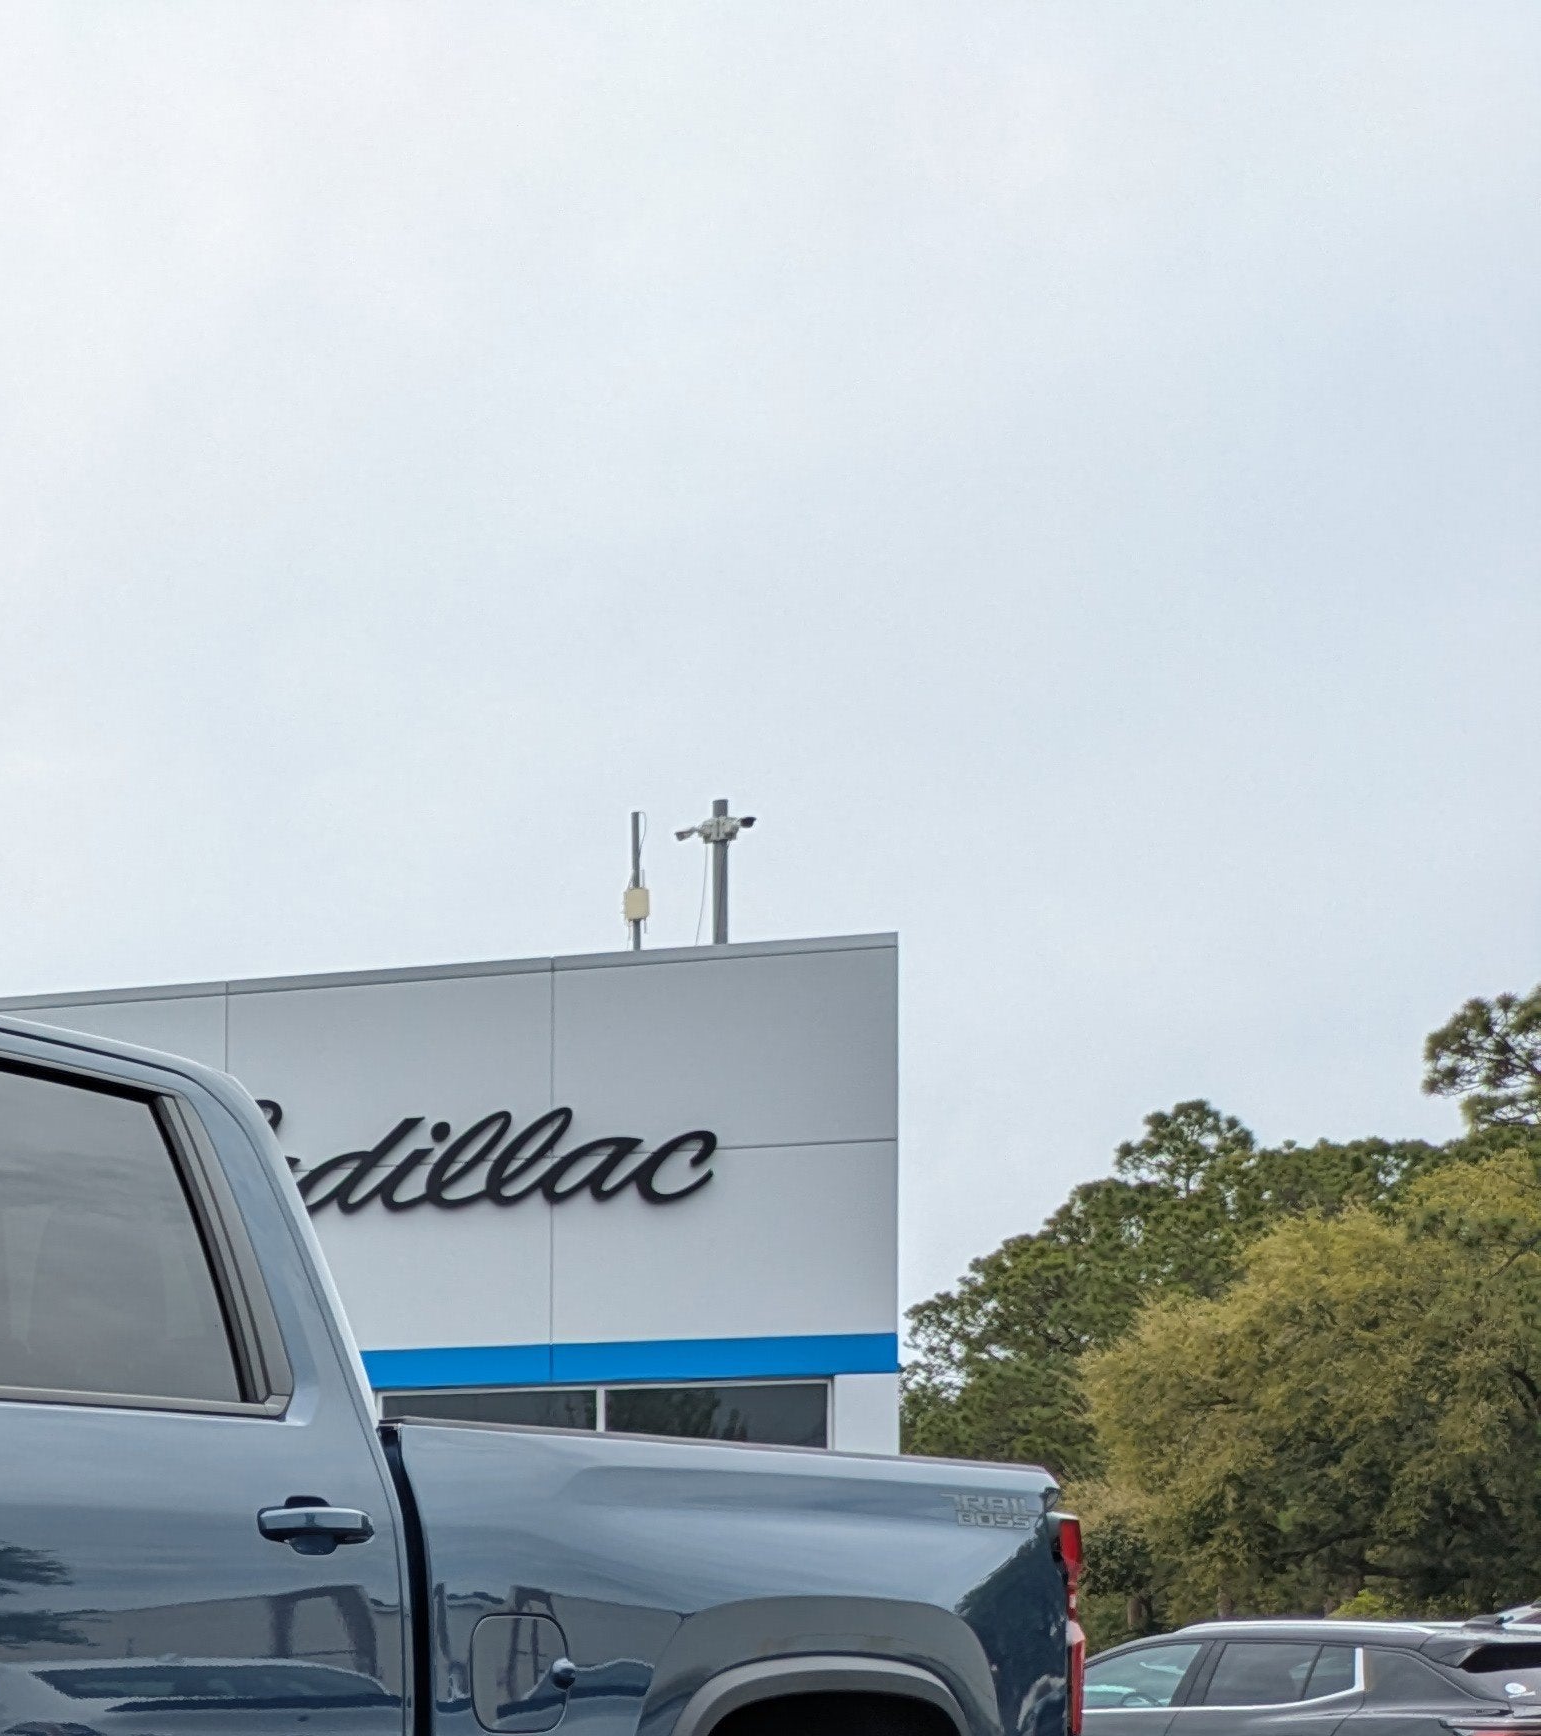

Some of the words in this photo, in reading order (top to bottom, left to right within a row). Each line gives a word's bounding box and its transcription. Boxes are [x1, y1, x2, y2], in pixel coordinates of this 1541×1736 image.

[255, 1098, 717, 1214] dillac
[940, 1493, 1039, 1515] TRAIL
[956, 1510, 1031, 1530] BOSS
